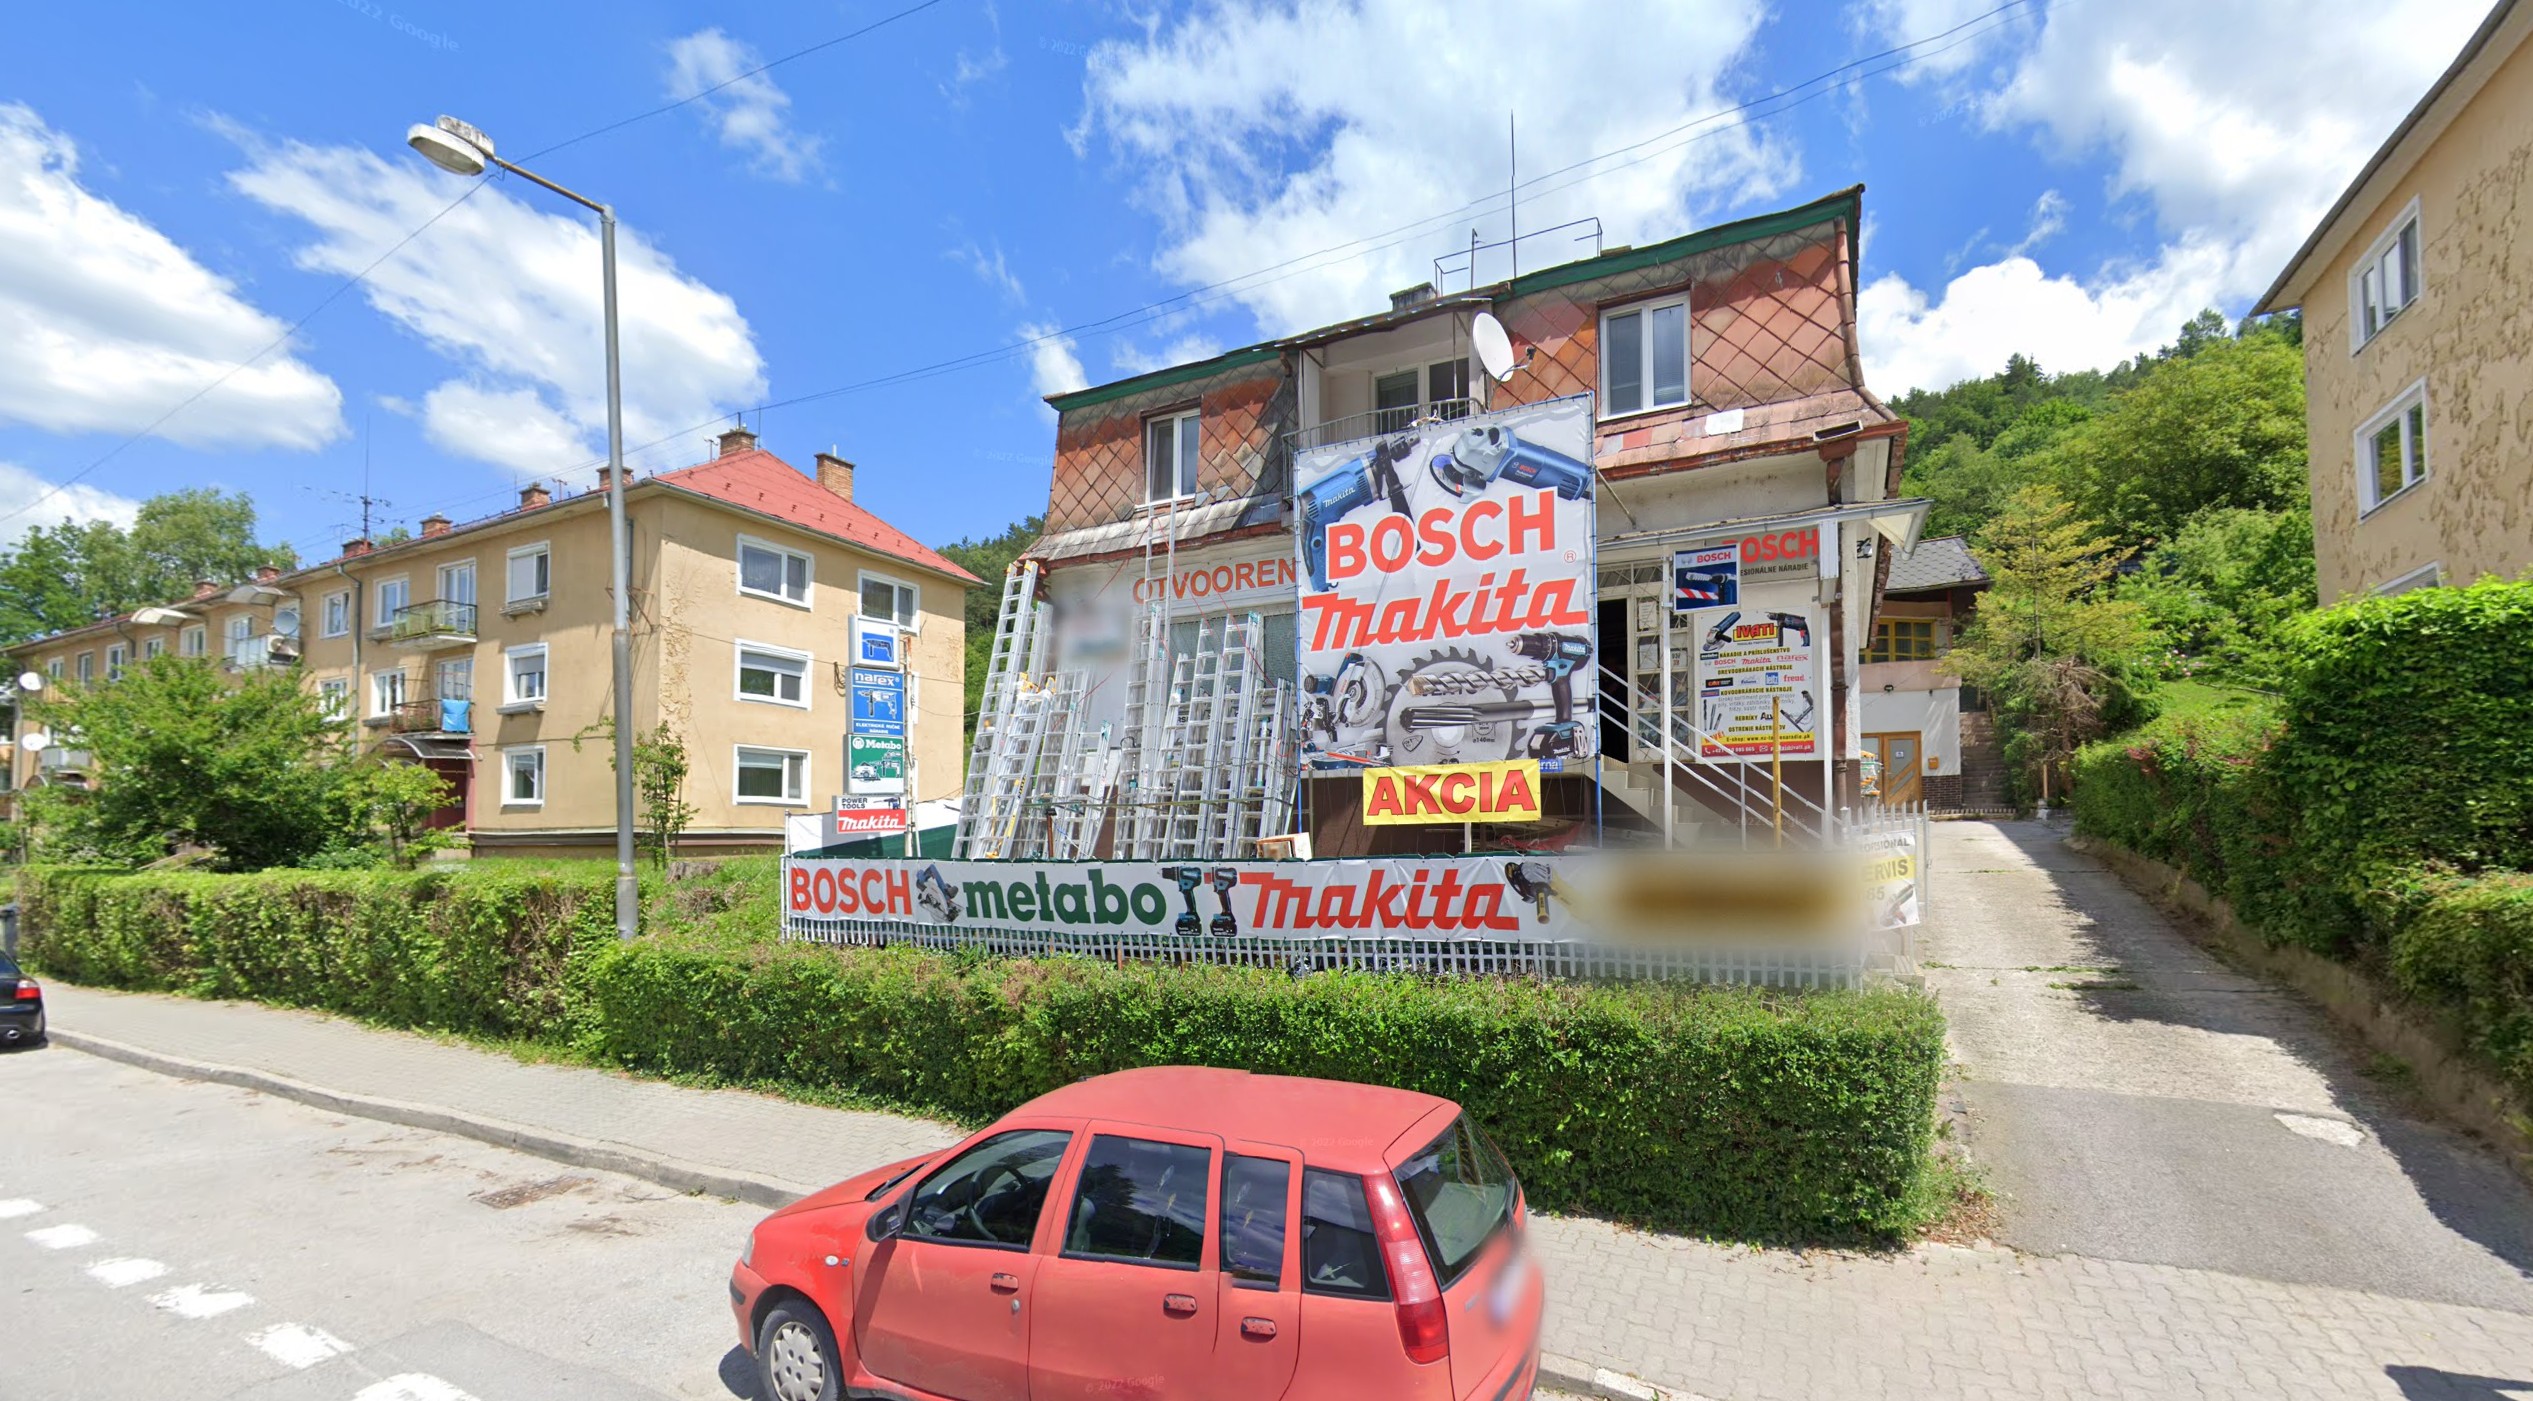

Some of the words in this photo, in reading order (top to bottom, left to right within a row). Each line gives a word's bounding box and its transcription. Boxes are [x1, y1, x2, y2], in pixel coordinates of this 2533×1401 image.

[1328, 490, 1556, 580] BOSCH
[1741, 529, 1819, 563] OSCH
[1696, 551, 1731, 564] BOSCH
[1740, 563, 1777, 577] ESIONÁLNE
[1778, 562, 1809, 573] NÁRADIE
[1736, 623, 1775, 638] IVATI
[865, 739, 902, 750] Metabo
[1539, 761, 1559, 771] rna
[1366, 769, 1538, 816] AKCIA
[1862, 858, 1909, 883] ERVIS
[791, 867, 913, 916] BOSCH
[963, 869, 1167, 926] metabo
